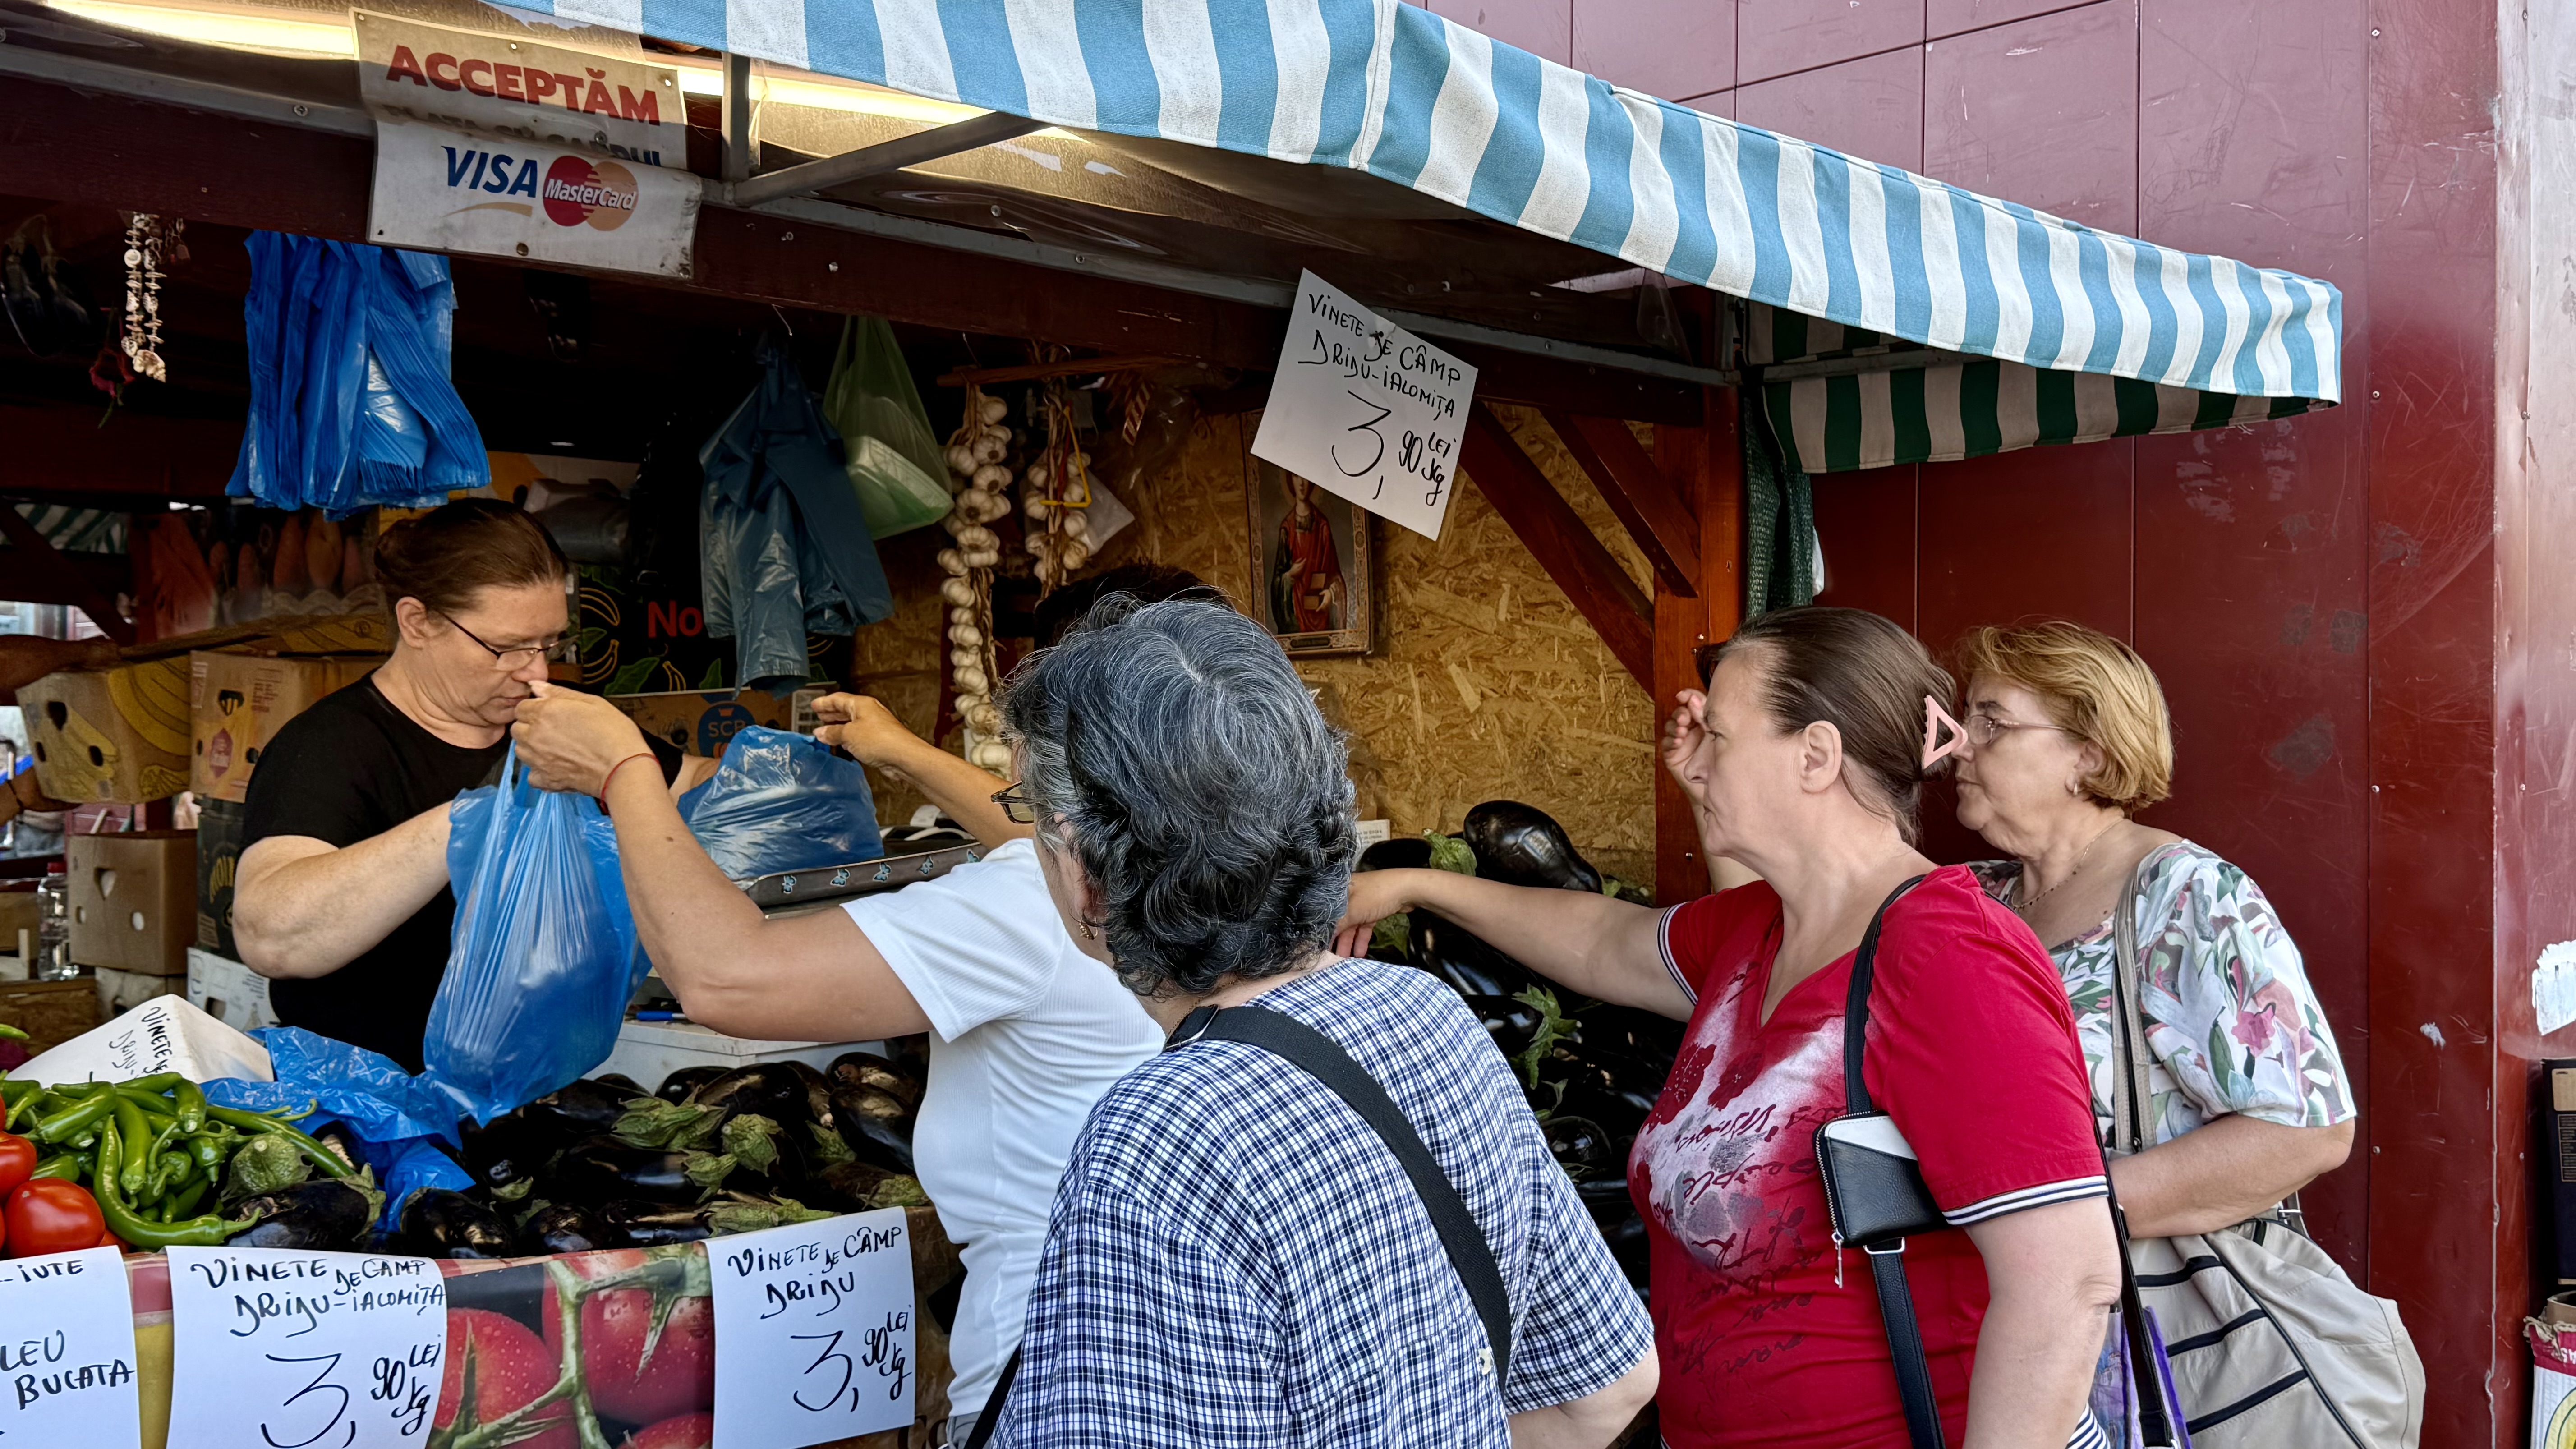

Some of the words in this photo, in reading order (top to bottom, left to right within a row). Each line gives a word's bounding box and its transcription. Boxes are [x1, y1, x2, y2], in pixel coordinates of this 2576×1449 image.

[386, 45, 660, 126] ACCEPTĂM
[441, 145, 538, 198] VISA
[545, 179, 637, 211] MasterCard
[1400, 345, 1461, 388] CÂMP
[844, 1227, 902, 1258] CÂMP
[0, 1329, 65, 1372] LEU
[14, 1359, 136, 1410] BUCATA
